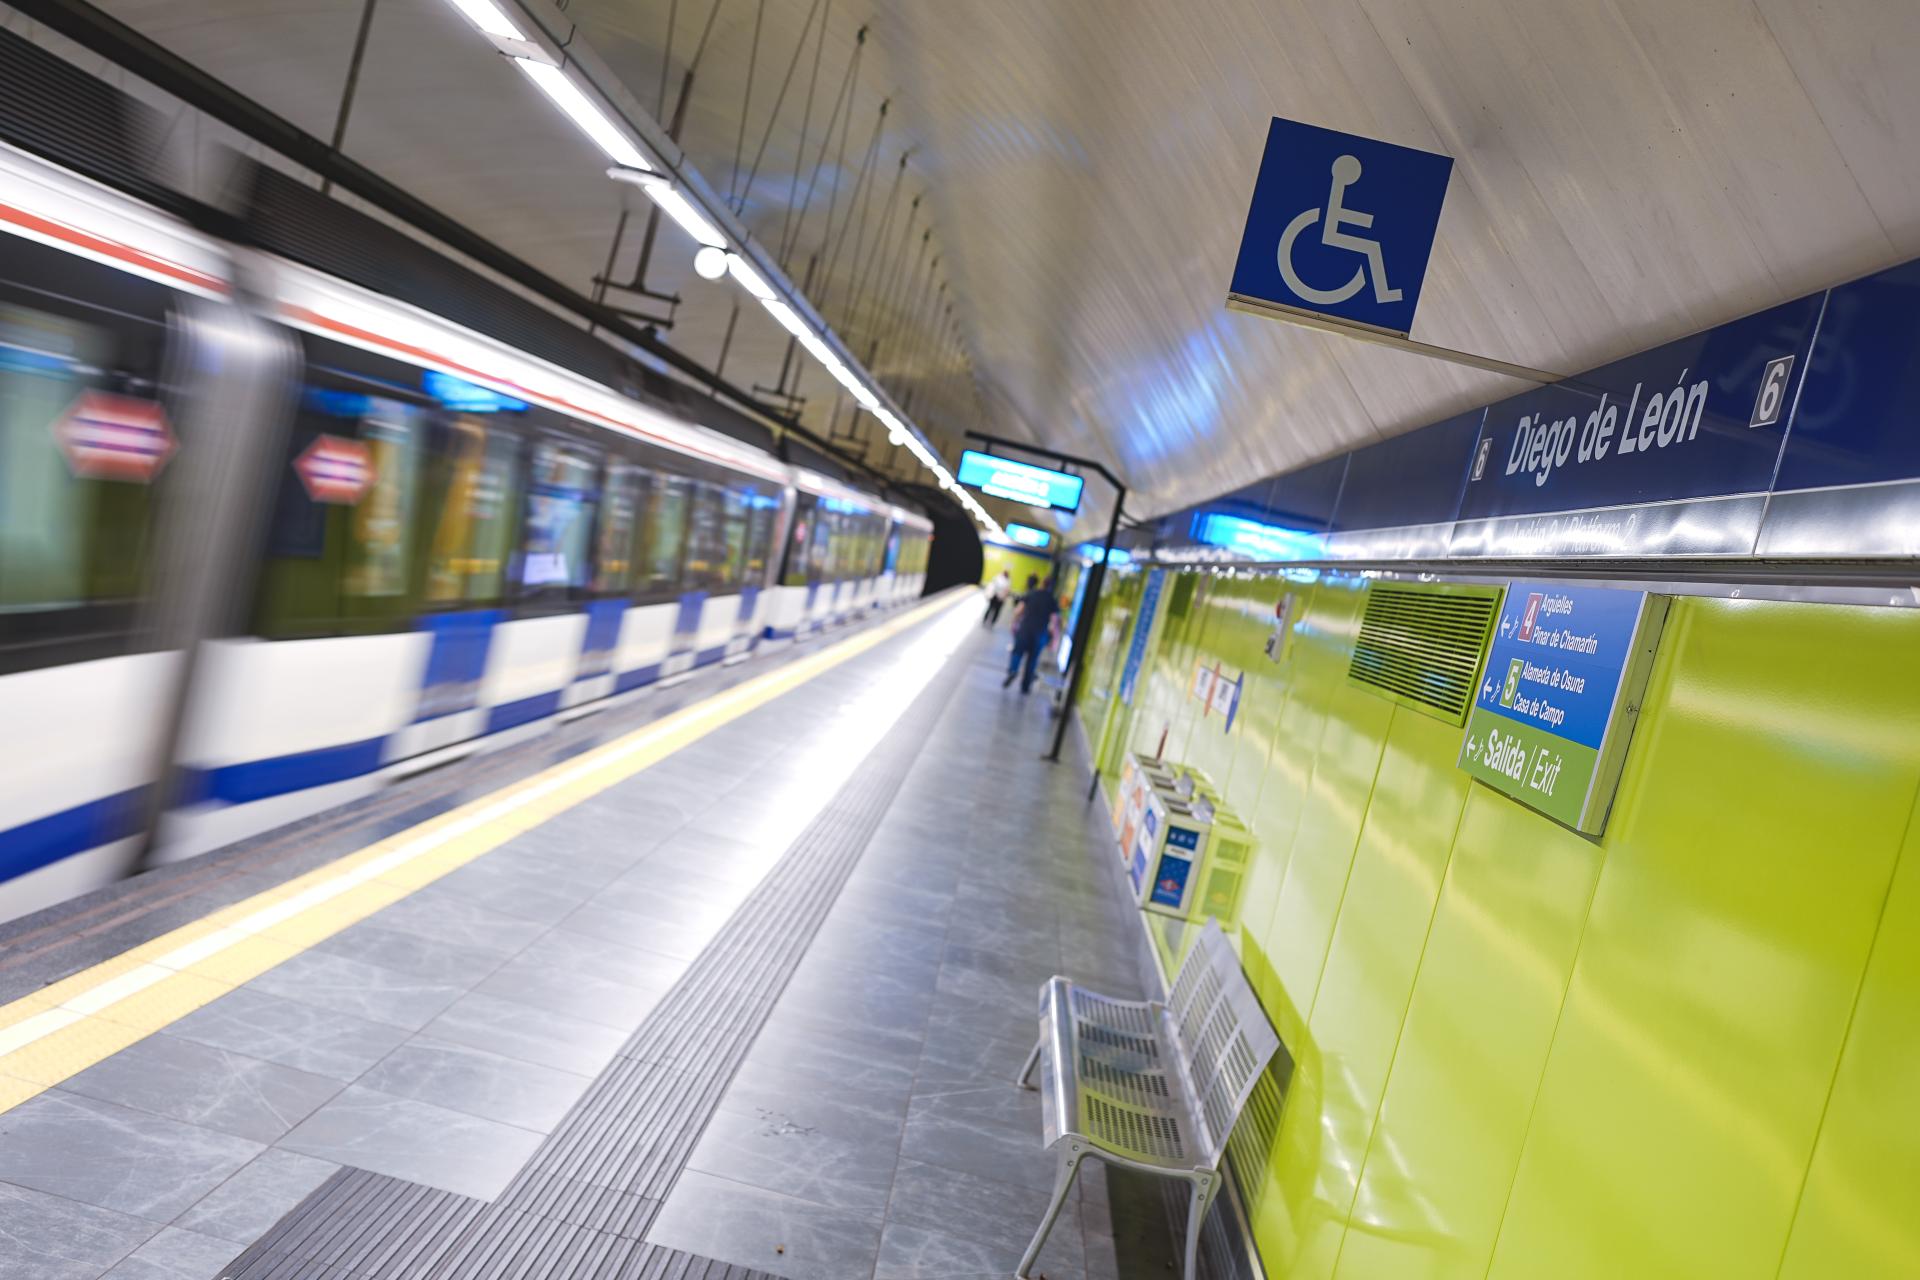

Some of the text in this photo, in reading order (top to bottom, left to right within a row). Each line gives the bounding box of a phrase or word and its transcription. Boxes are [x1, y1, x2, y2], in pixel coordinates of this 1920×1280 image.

[1758, 362, 1785, 421] 6
[1505, 367, 1709, 487] Diego de León
[1475, 441, 1489, 478] 6
[1523, 600, 1538, 635] 4
[1540, 593, 1573, 617] Argüelles
[1532, 625, 1598, 655] Pinar de Chamartín
[1504, 665, 1519, 700] 5
[1521, 660, 1585, 694] Alameda de Osuna
[1513, 692, 1565, 729] Casa de Campo
[1484, 728, 1562, 797] Salida Exit
